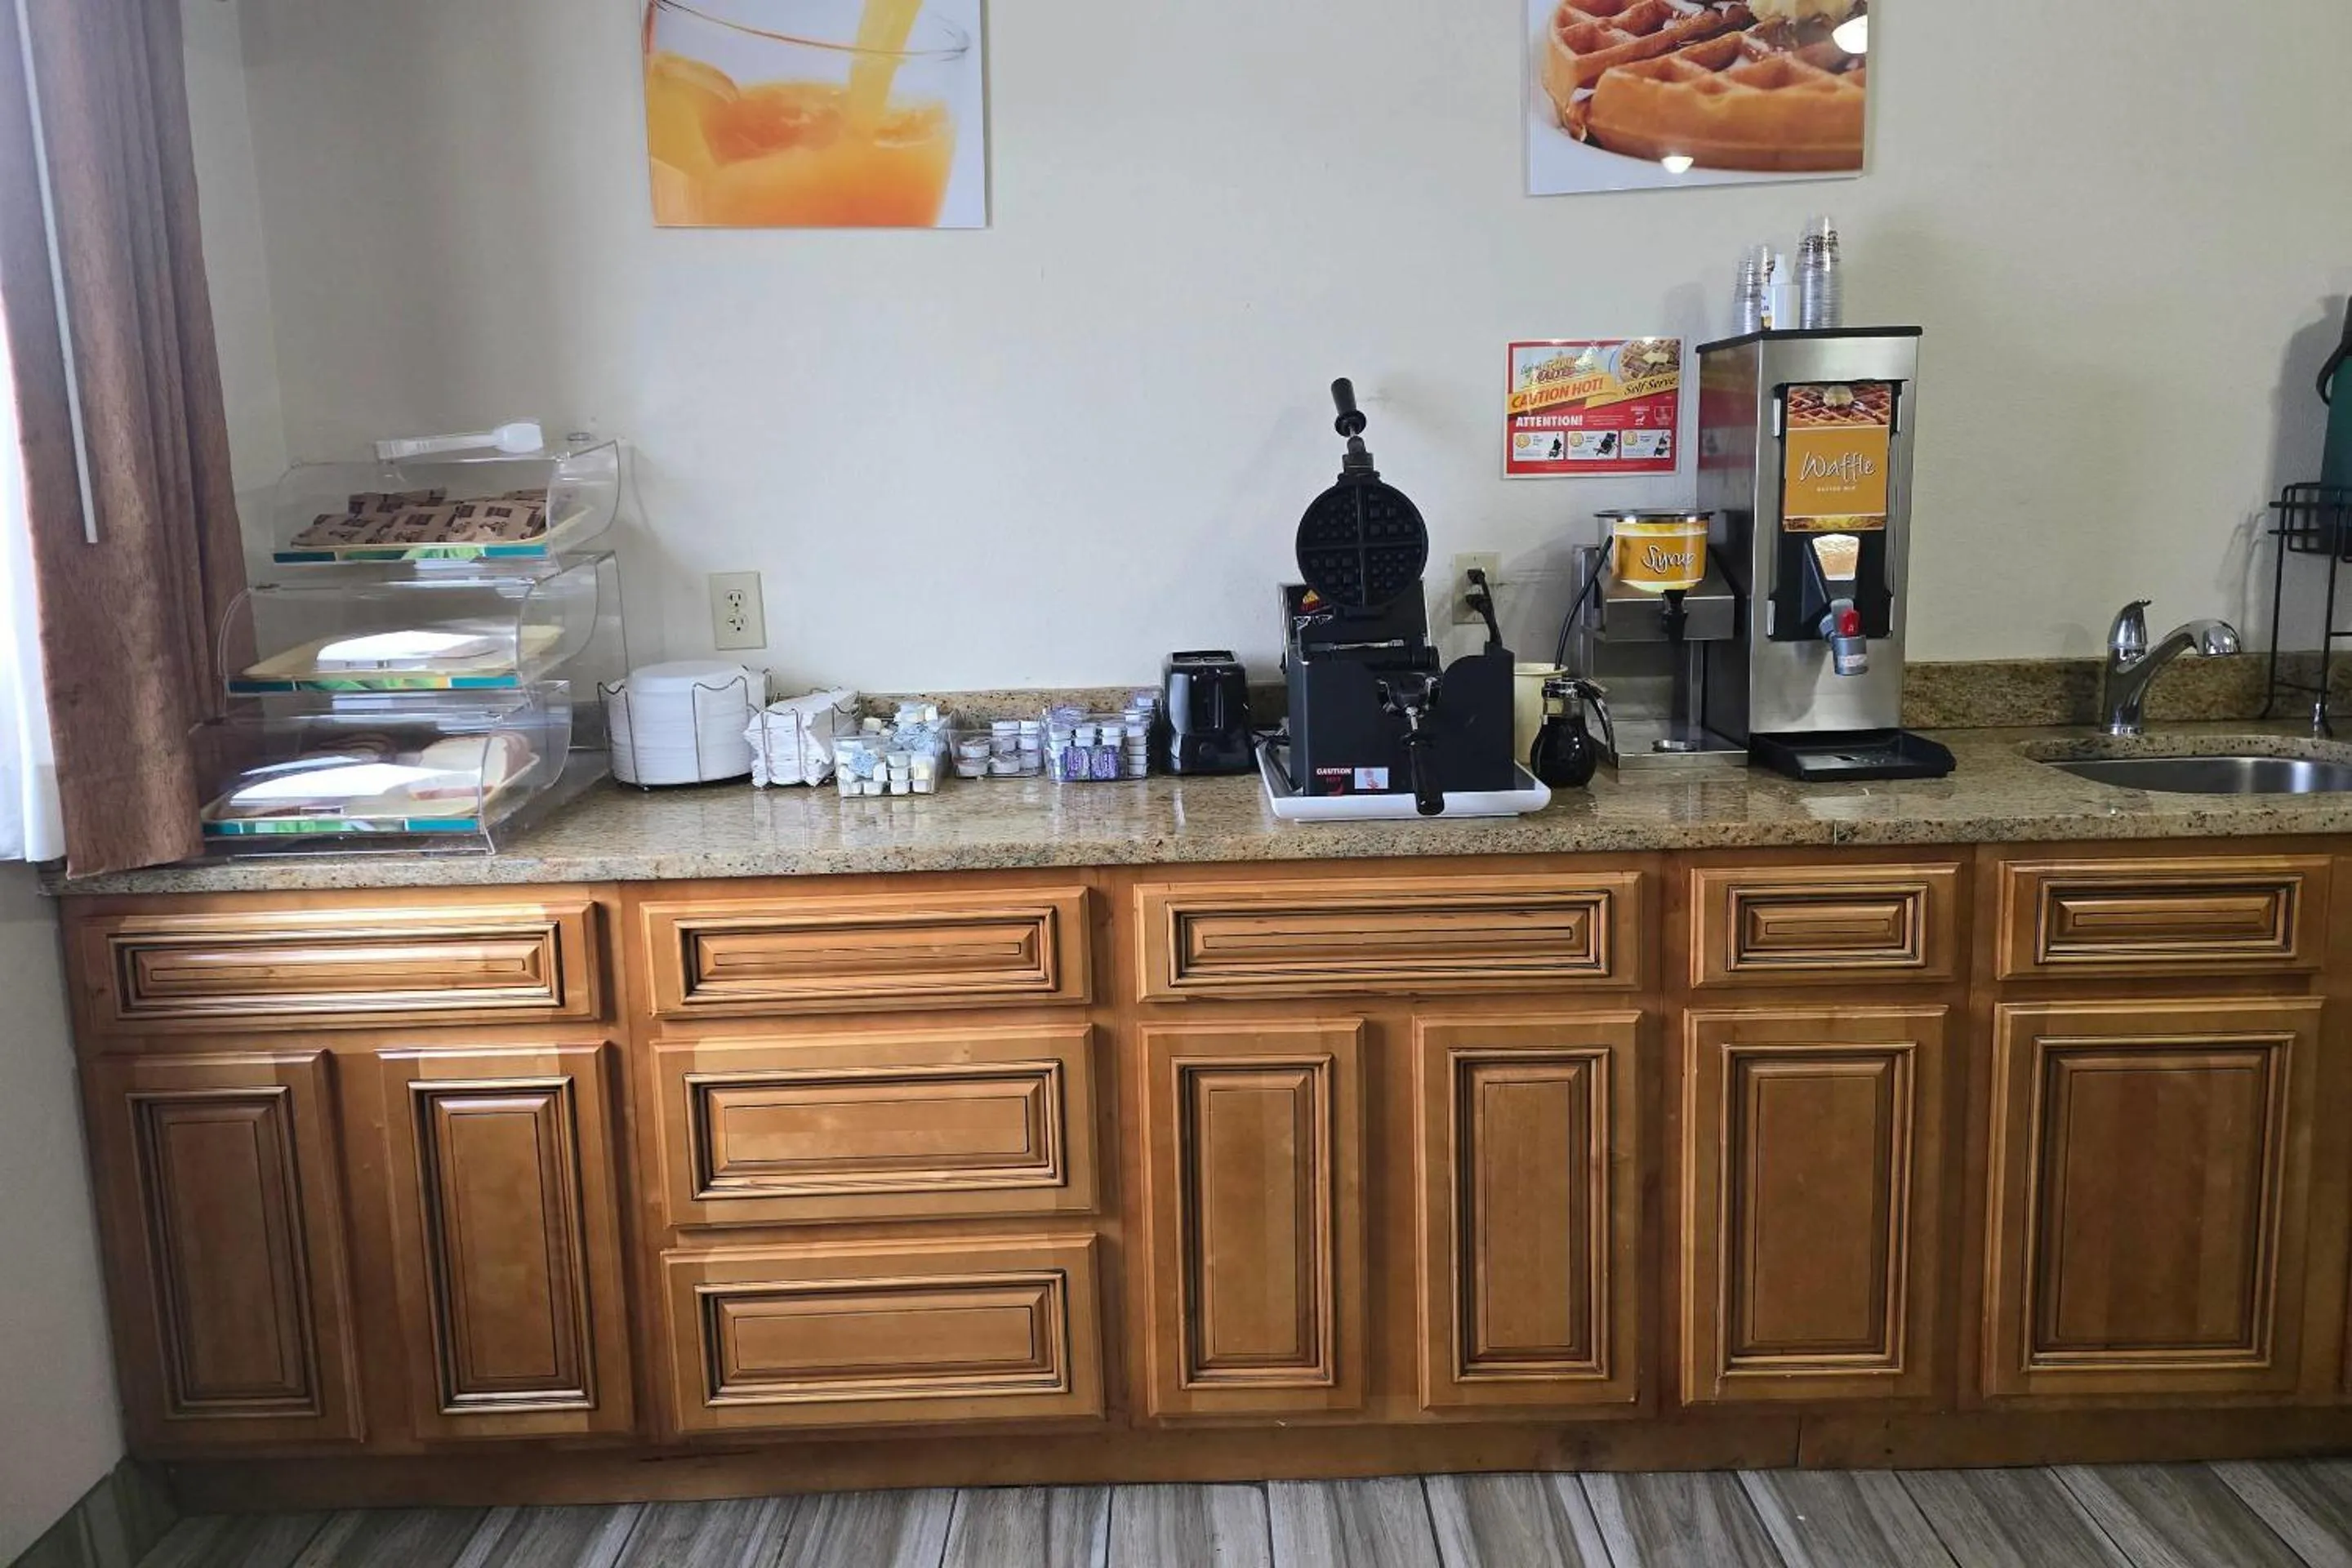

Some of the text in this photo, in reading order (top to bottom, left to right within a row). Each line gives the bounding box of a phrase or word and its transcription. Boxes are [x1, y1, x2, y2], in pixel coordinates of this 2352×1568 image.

[1511, 376, 1604, 408] CAUTION HOT!
[1624, 377, 1676, 395] Self Serve
[1516, 415, 1583, 427] ATTENTION!
[1800, 452, 1876, 482] Waffle
[1642, 545, 1695, 574] Syrup
